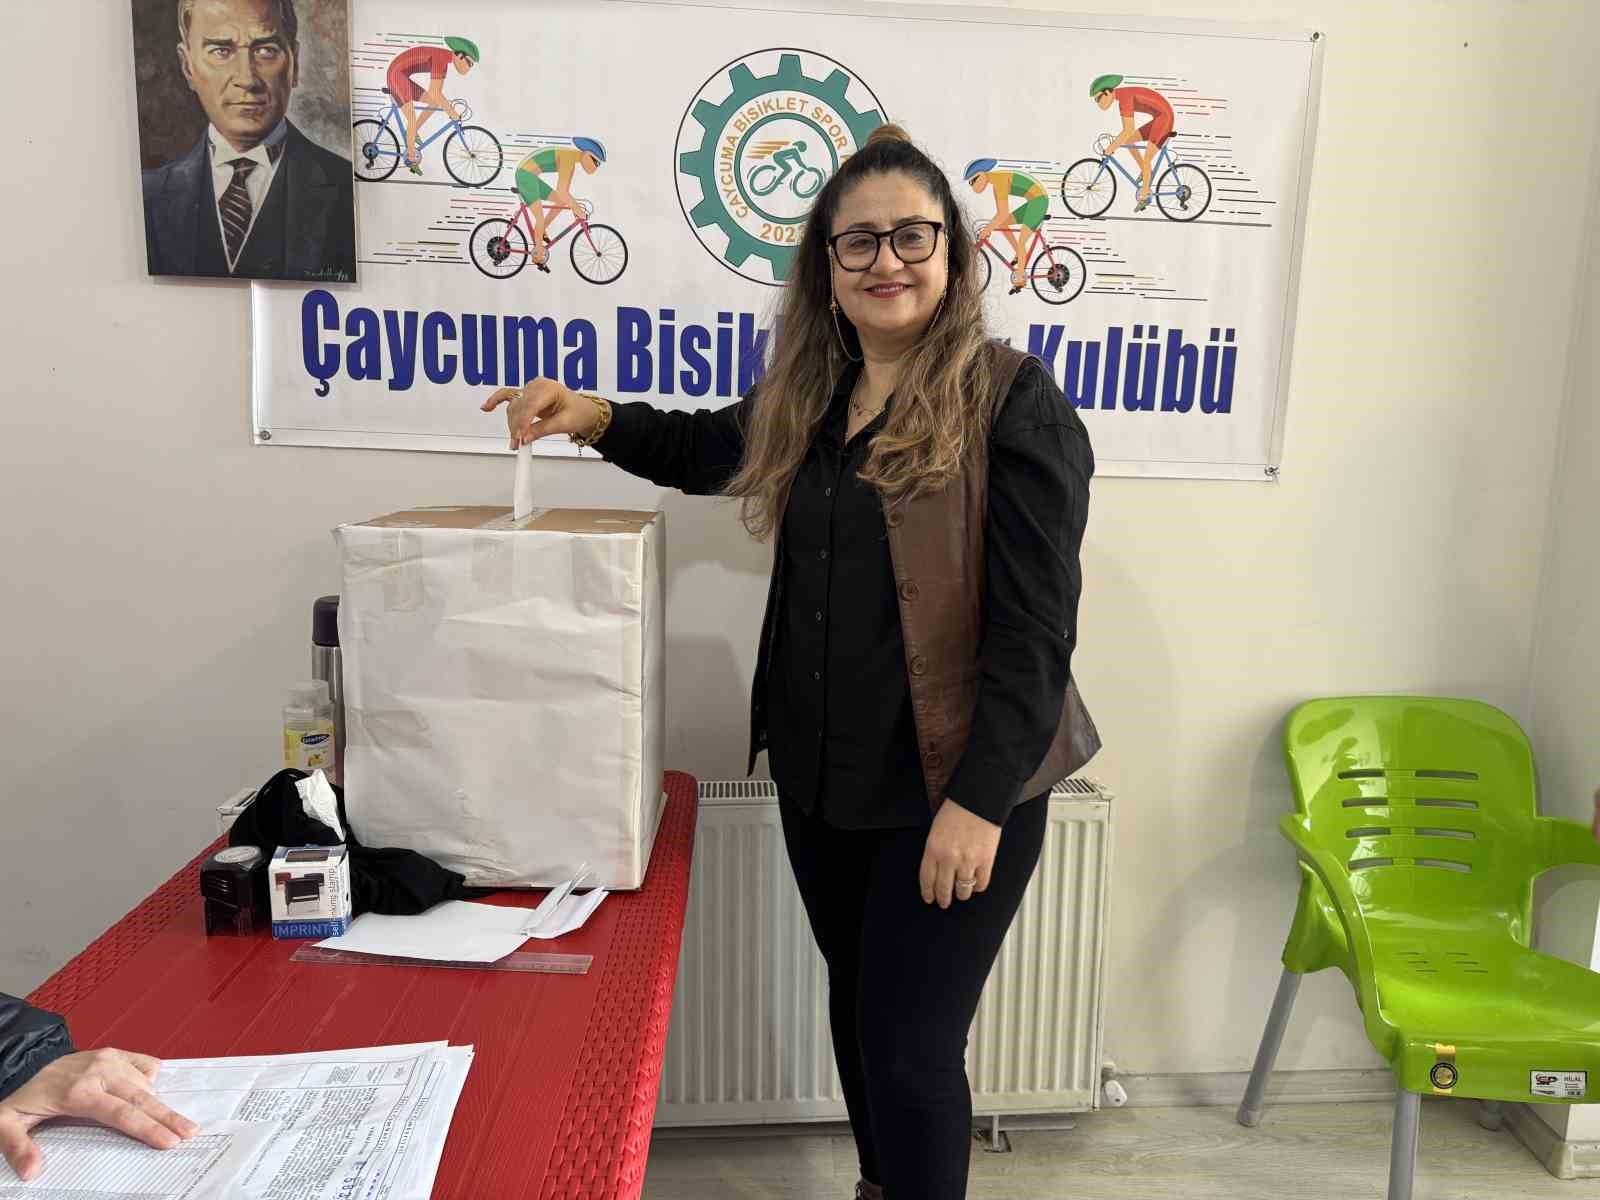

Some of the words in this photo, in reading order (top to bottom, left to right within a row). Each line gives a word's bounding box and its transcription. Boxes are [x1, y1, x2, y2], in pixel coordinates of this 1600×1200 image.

[811, 105, 848, 150] SPOR
[301, 289, 598, 397] Çaycuma
[616, 306, 772, 397] Bisik
[1027, 323, 1238, 414] Kulübü
[273, 922, 328, 936] IMPRINT
